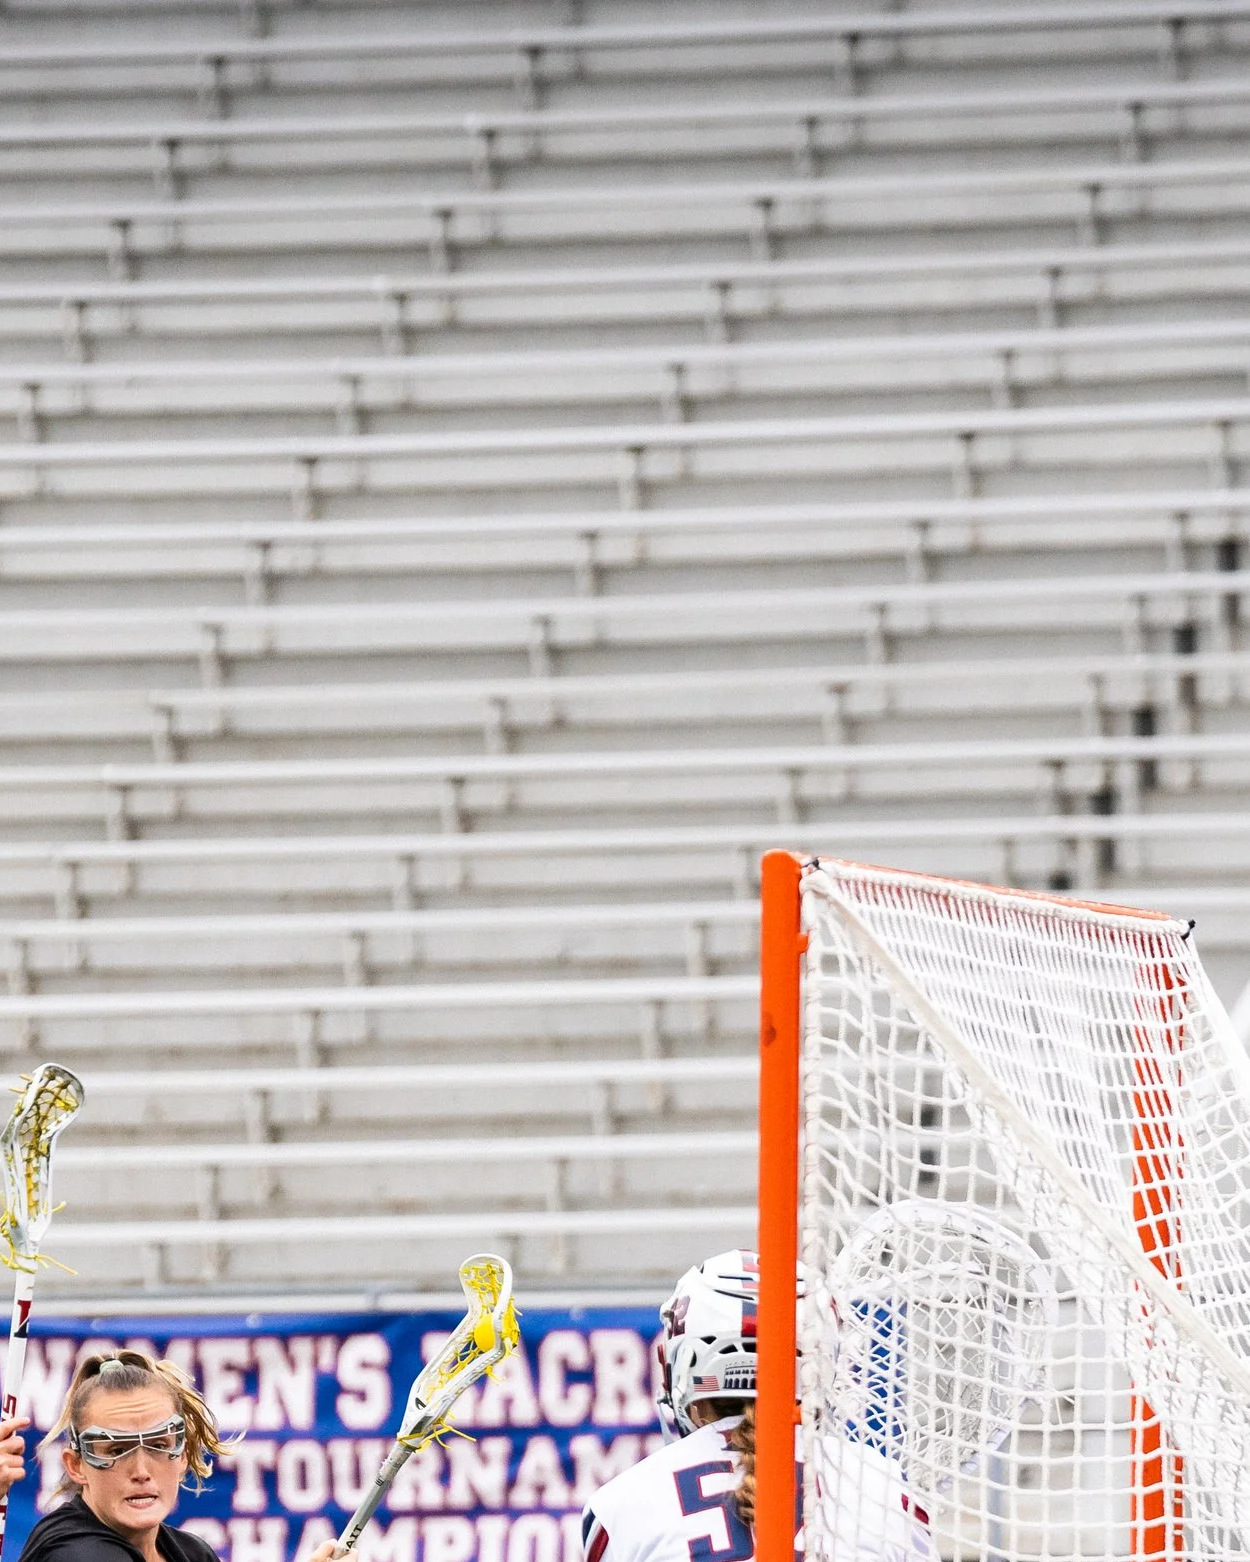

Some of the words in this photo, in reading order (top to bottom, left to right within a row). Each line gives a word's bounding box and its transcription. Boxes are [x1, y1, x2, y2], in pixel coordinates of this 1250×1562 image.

[421, 1331, 662, 1427] LACR
[217, 1434, 657, 1513] TOURNAM
[345, 1524, 363, 1551] AIT
